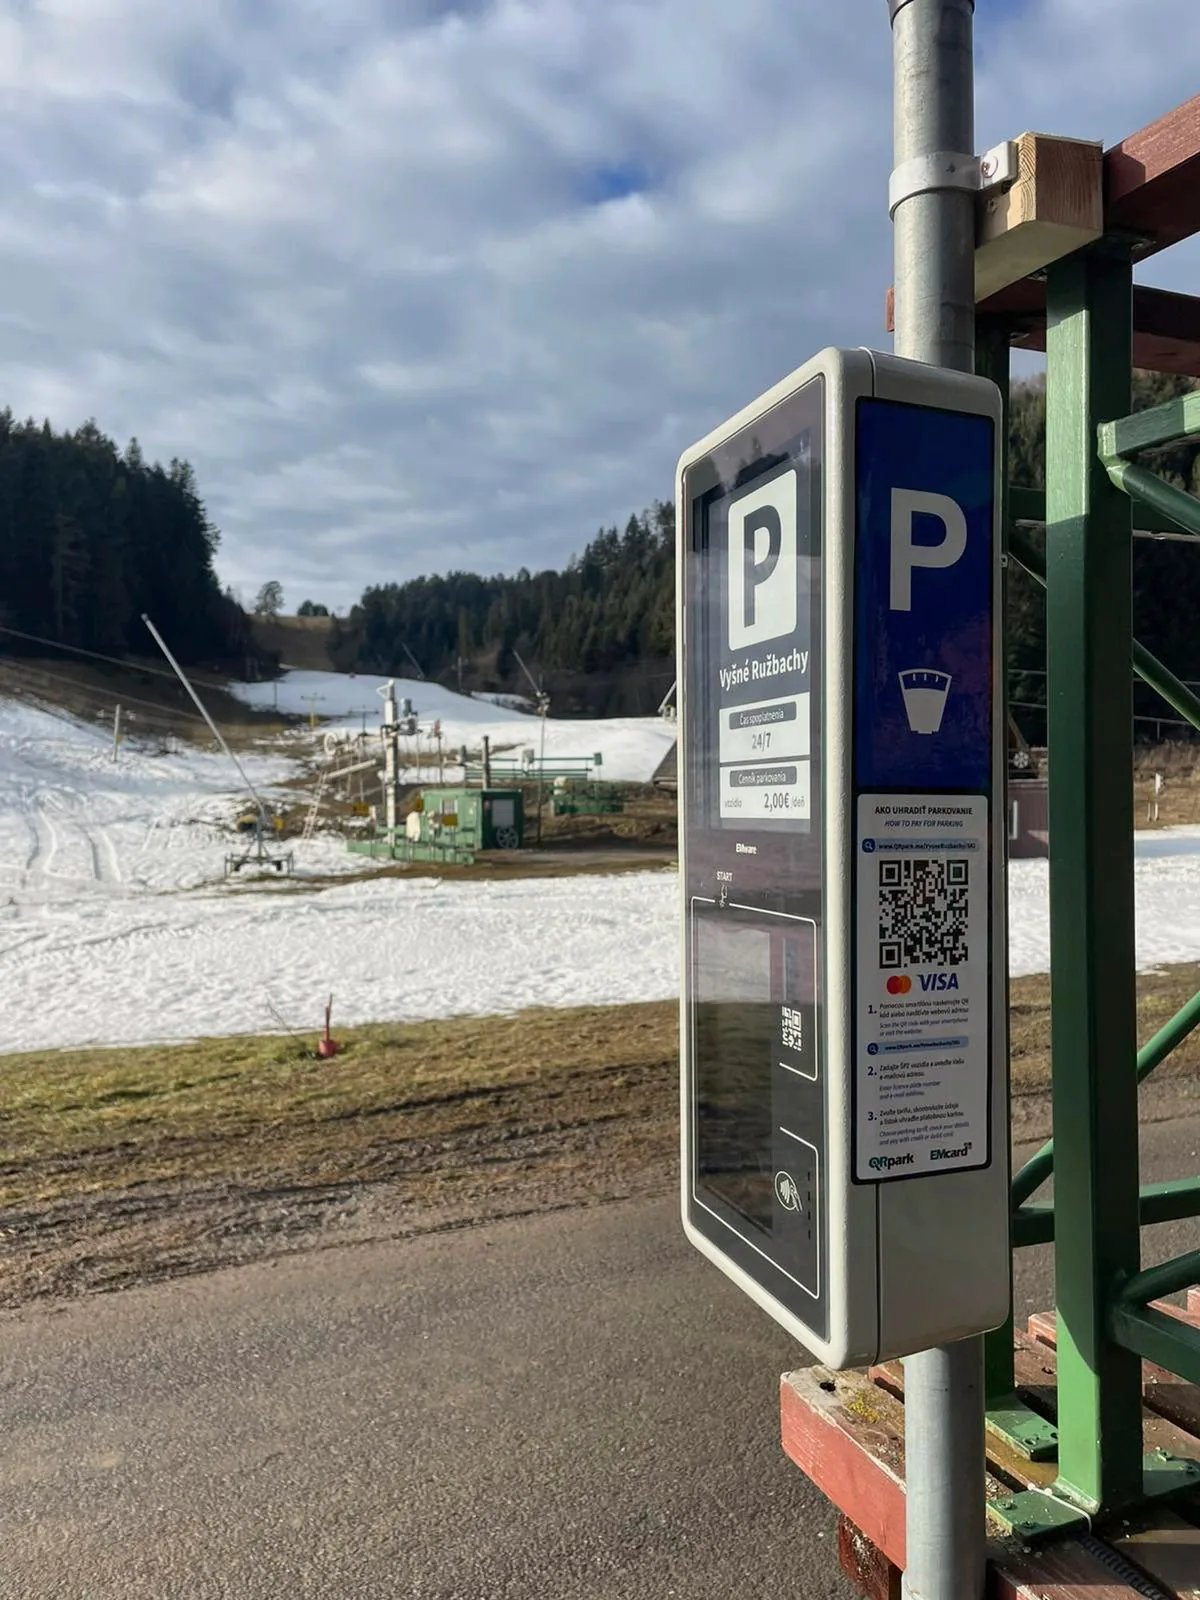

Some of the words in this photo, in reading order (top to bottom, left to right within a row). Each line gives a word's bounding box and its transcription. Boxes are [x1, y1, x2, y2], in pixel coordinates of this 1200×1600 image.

[889, 487, 968, 611] P
[743, 504, 782, 628] P
[720, 659, 749, 691] Vyšné
[752, 648, 808, 680] Ružbachy
[752, 732, 771, 752] 24/7
[764, 792, 790, 812] 2,00€
[875, 806, 891, 814] AKO
[892, 804, 926, 814] UHRADIŤ
[928, 807, 973, 815] PARKOVANIE
[716, 871, 733, 882] START
[917, 972, 959, 992] VISA
[868, 1004, 877, 1014] 1.
[868, 1065, 877, 1076] 2.
[868, 1111, 877, 1121] 3.
[869, 1152, 914, 1171] QRpark
[930, 1146, 968, 1160] EMcard
